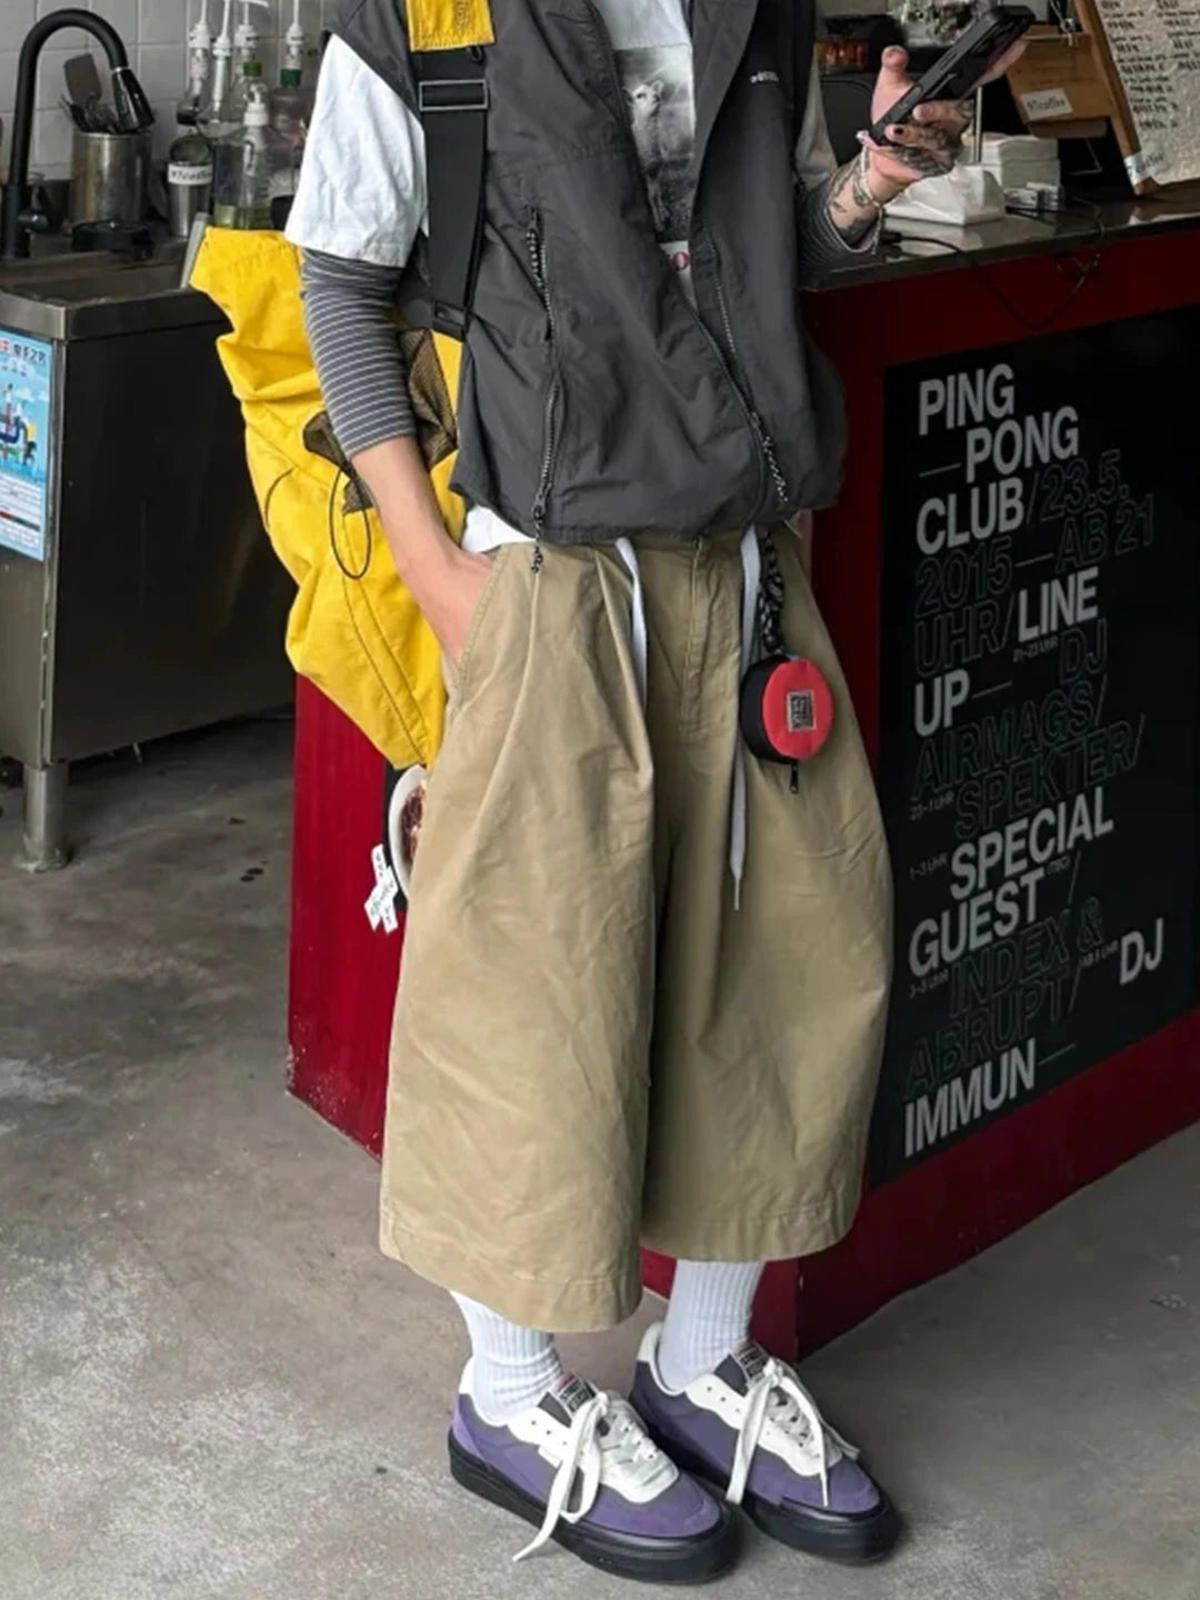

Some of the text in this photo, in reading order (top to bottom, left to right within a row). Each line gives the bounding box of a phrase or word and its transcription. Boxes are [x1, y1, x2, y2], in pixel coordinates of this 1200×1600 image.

[919, 362, 1014, 435] PING
[966, 406, 1080, 483] PONG
[915, 475, 1025, 556] CLUB
[914, 493, 1156, 618] 2015 AB 21
[1017, 565, 1100, 643] LINE
[1059, 618, 1107, 685] DJ
[913, 667, 970, 737] UP
[949, 785, 1114, 901] SPECIAL
[909, 868, 1045, 977] GUEST
[947, 896, 1106, 1018] INDEX &
[1118, 916, 1165, 986] DJ
[904, 1038, 1036, 1158] IMMUN
